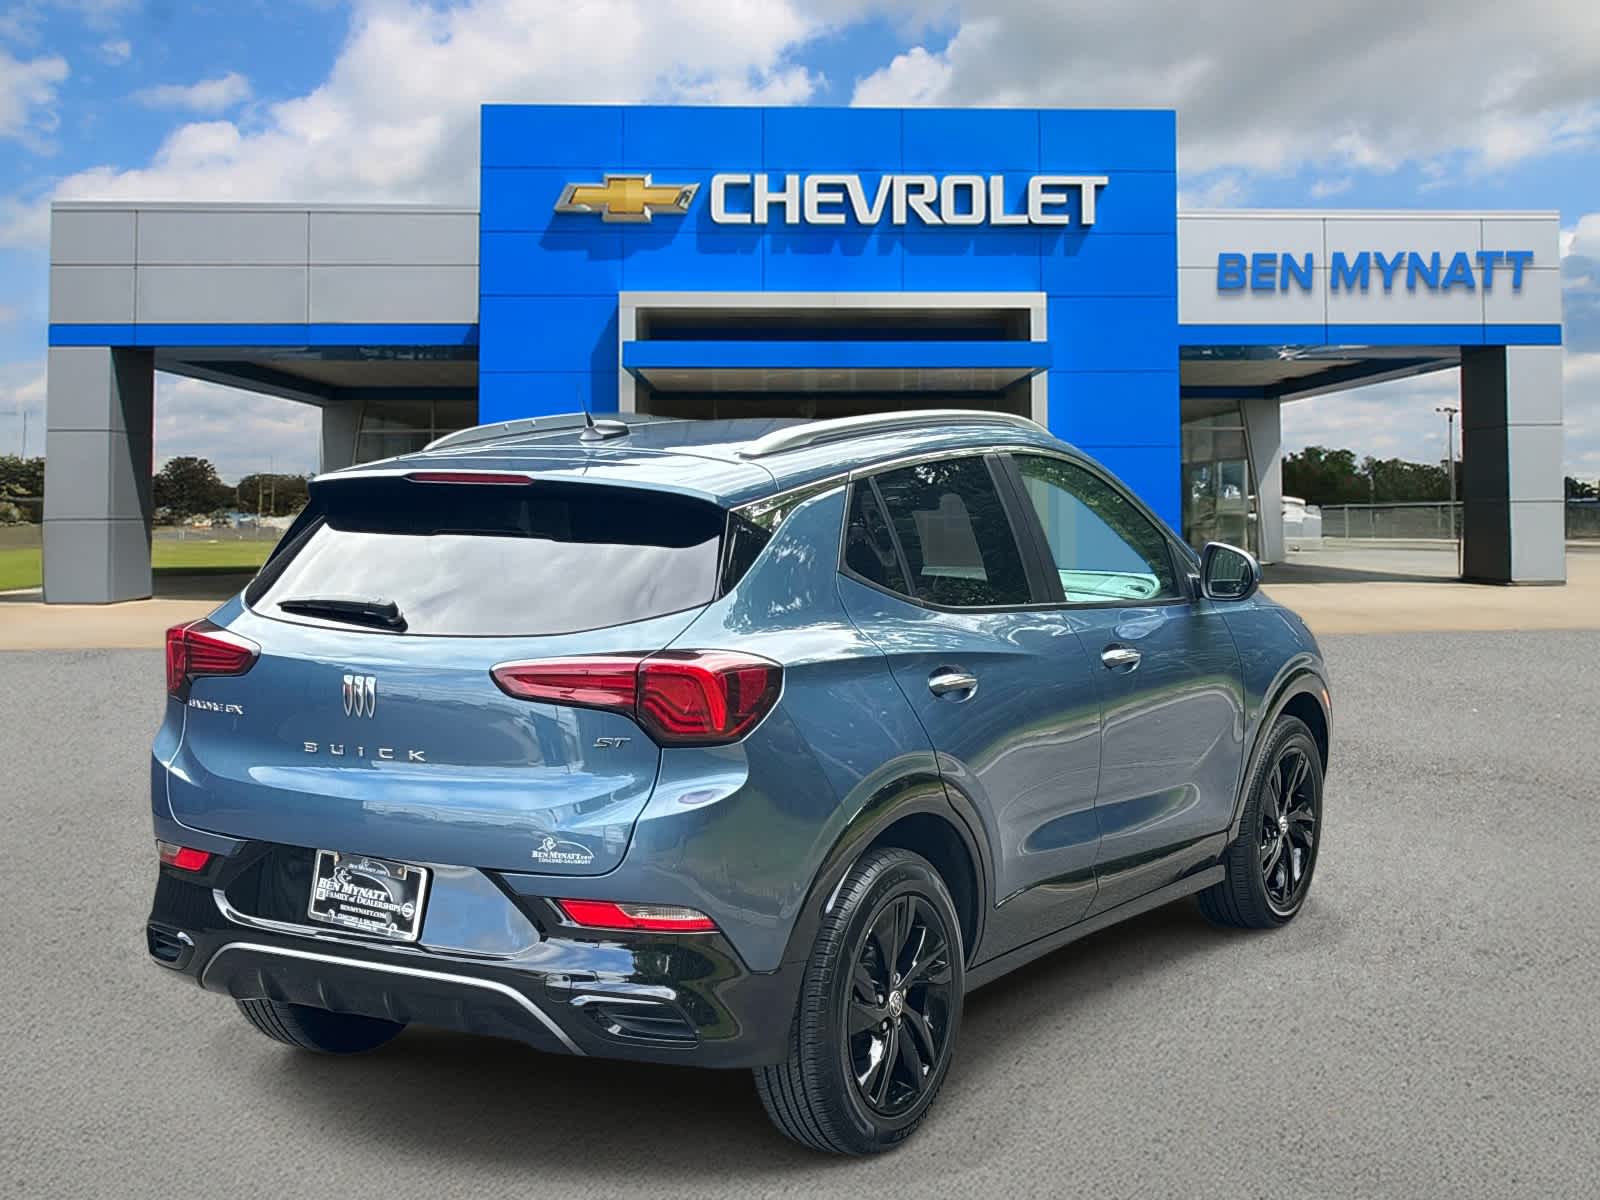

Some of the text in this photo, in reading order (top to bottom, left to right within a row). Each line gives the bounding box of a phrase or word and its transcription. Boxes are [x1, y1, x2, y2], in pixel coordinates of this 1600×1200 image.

[711, 173, 1109, 225] CHEVROLET
[1217, 251, 1534, 290] BEN MYNATT
[303, 741, 427, 762] BUICK
[592, 737, 631, 748] ST
[318, 877, 388, 901] BEN MYNATT
[325, 890, 350, 902] FAMILY
[357, 896, 402, 913] DEALERSHIPS
